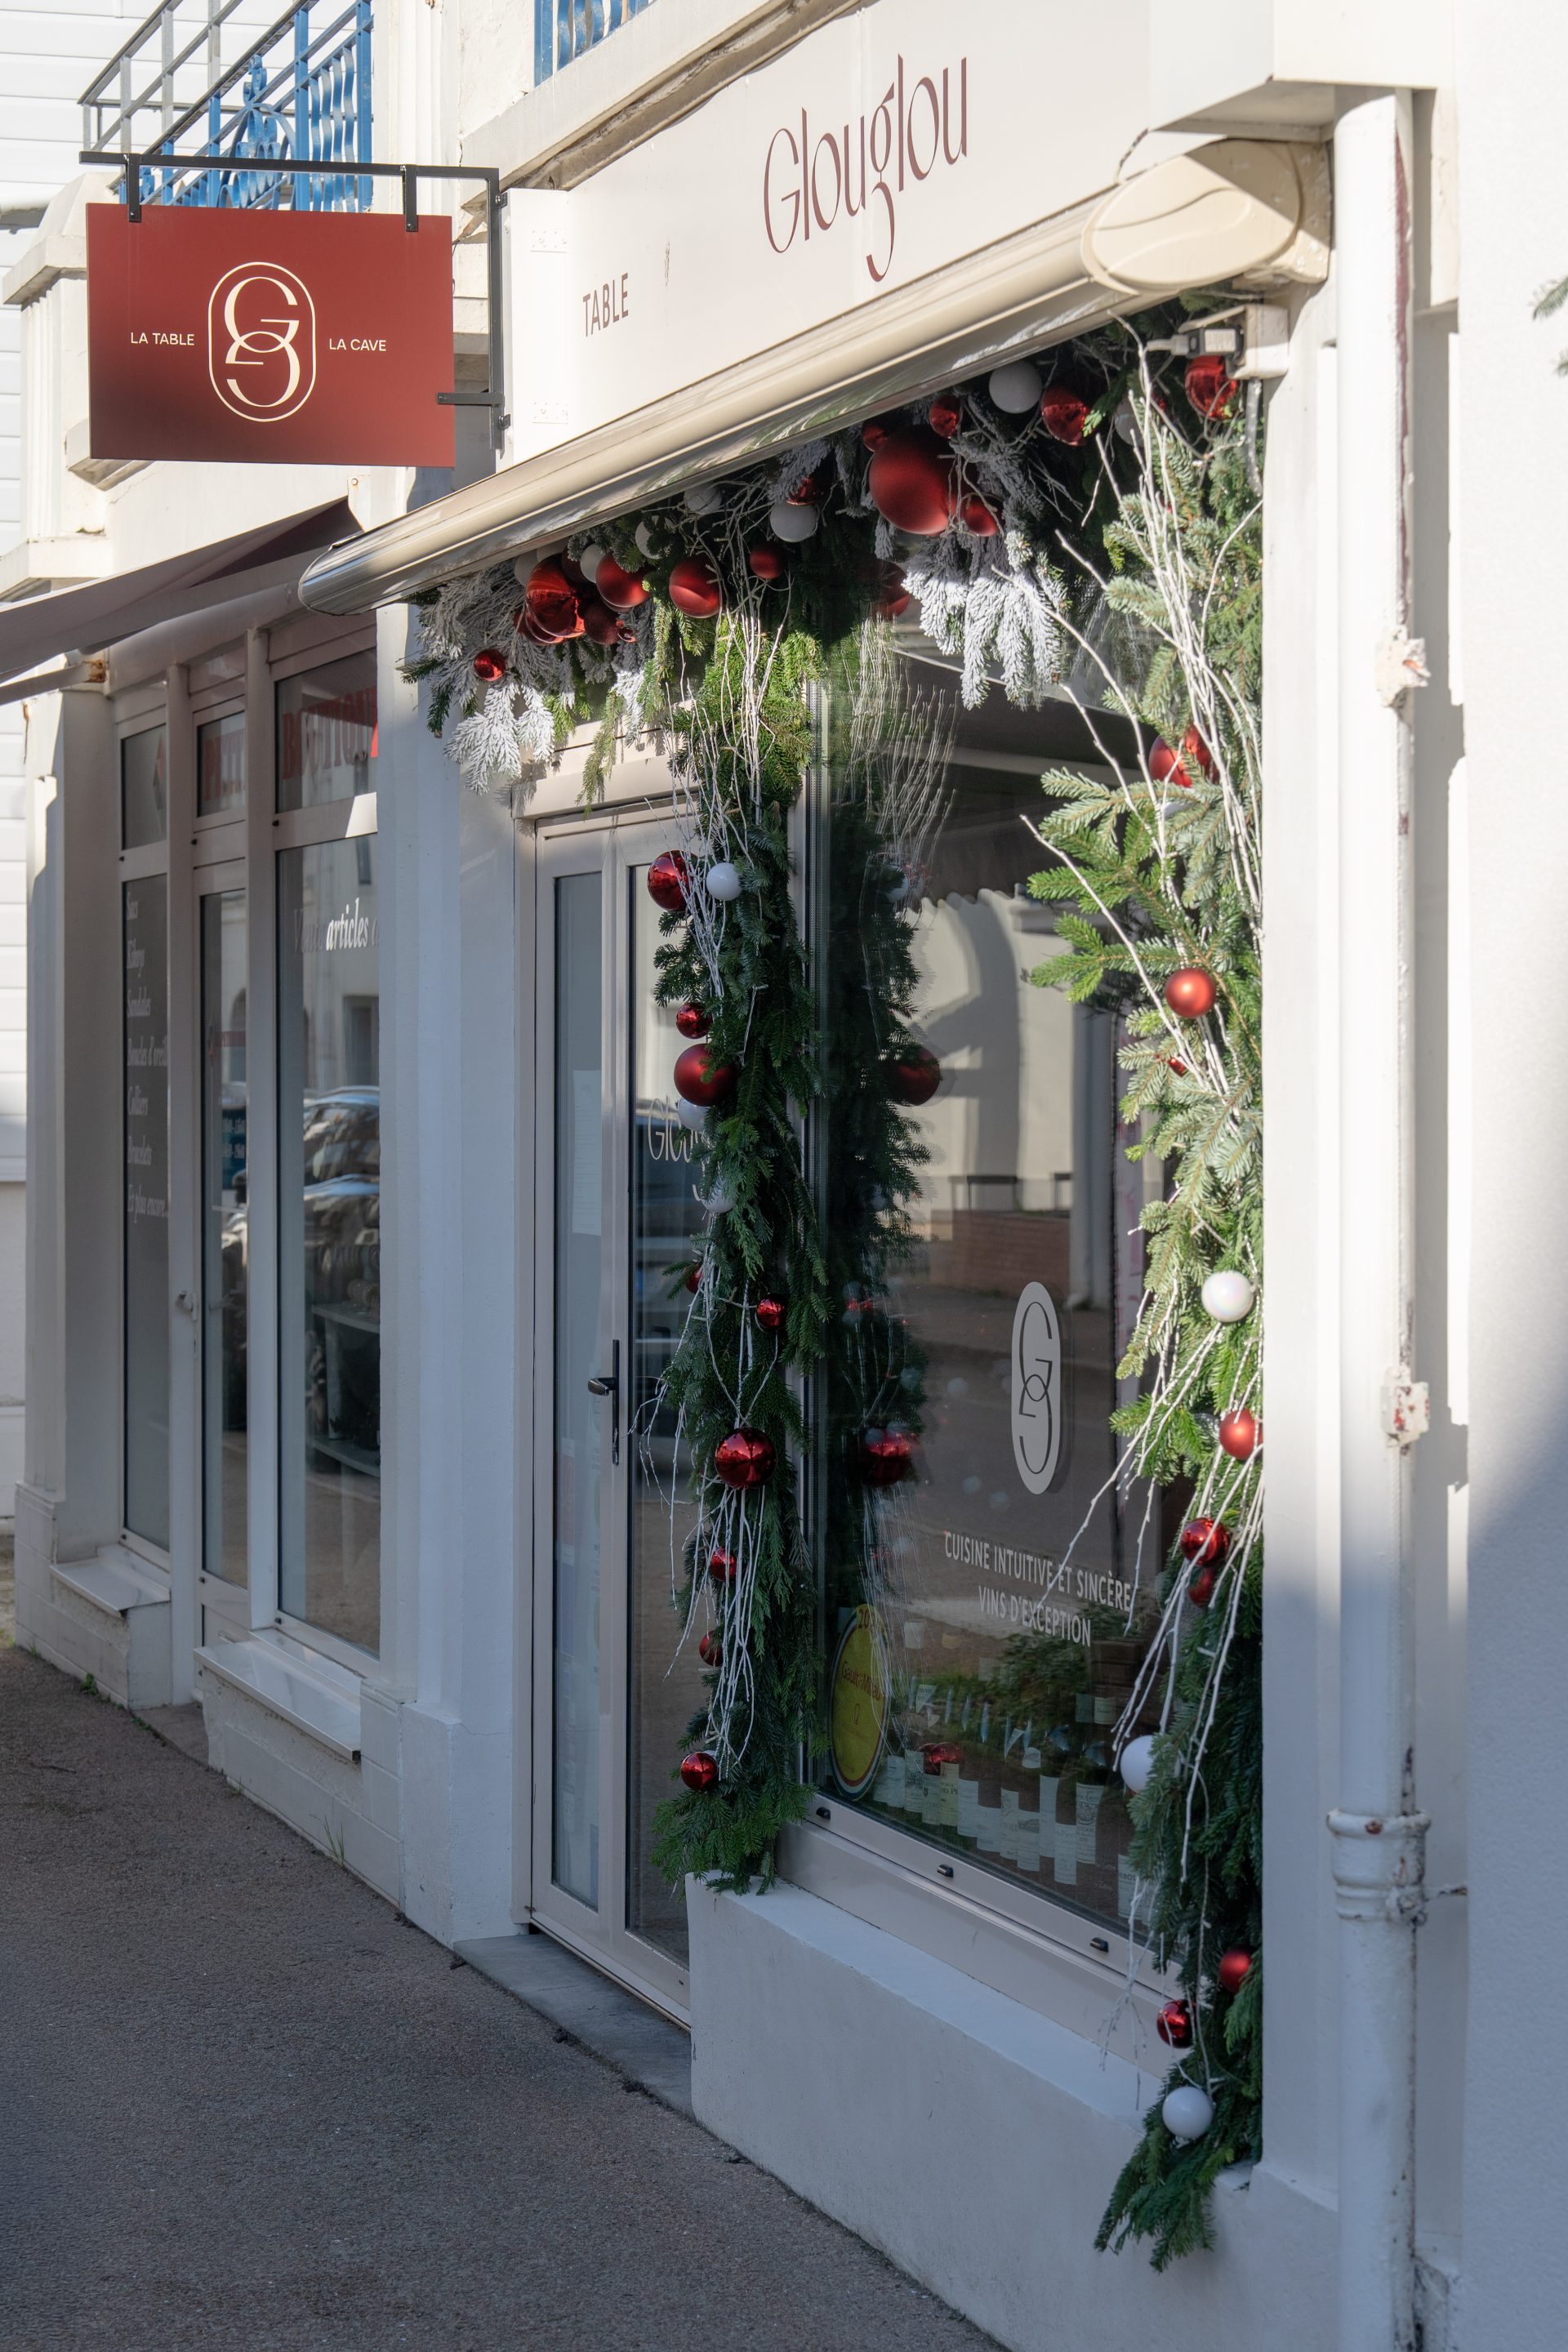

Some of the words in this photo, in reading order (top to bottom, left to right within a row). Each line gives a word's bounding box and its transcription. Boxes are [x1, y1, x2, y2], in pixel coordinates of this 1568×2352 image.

[763, 53, 968, 283] Glouglou
[582, 272, 630, 338] TABLE
[131, 332, 149, 345] LA
[152, 332, 194, 346] TABLE
[328, 337, 347, 351] LA
[350, 338, 386, 352] CAVE
[326, 897, 369, 951] articles
[945, 1531, 990, 1570] CUISINE
[994, 1545, 1054, 1588] INTUITIVE
[1058, 1563, 1072, 1594] ET
[1076, 1569, 1132, 1613] SINCÈRE
[978, 1584, 1006, 1619] VINS
[1010, 1594, 1091, 1647] D'EXCEPTION
